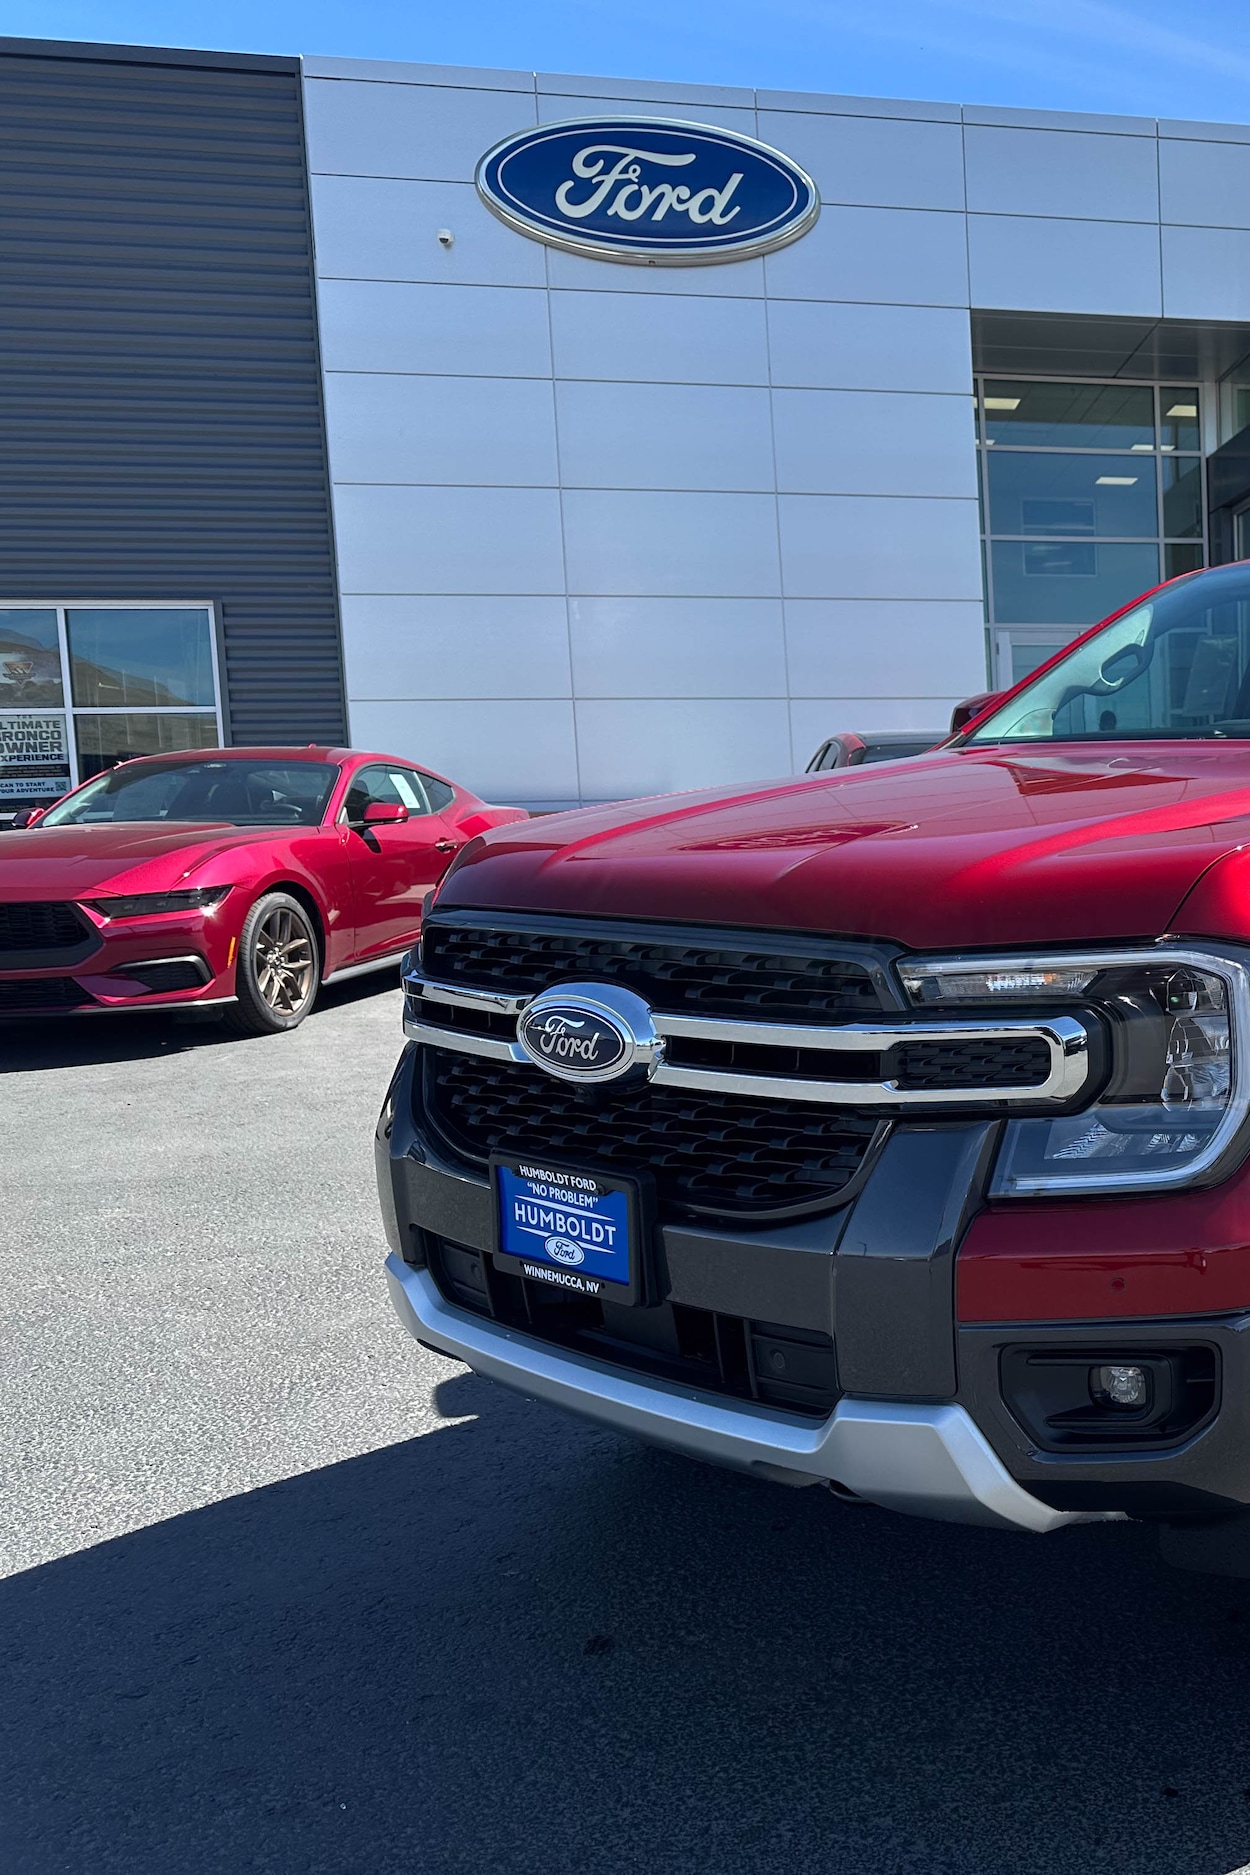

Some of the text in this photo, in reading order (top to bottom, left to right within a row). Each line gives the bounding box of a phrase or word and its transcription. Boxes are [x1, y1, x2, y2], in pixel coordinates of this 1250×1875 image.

[555, 144, 745, 225] Ford
[0, 720, 61, 730] LTIMATE
[0, 730, 62, 741] RONCO
[0, 753, 64, 762] XPERIENCE
[540, 1015, 600, 1060] Ford
[519, 1165, 597, 1192] HUMBOLDT FORD
[514, 1202, 617, 1246] HUMBOLDT
[553, 1240, 576, 1261] Ford
[523, 1263, 600, 1294] WINNEMUCCA, NV
